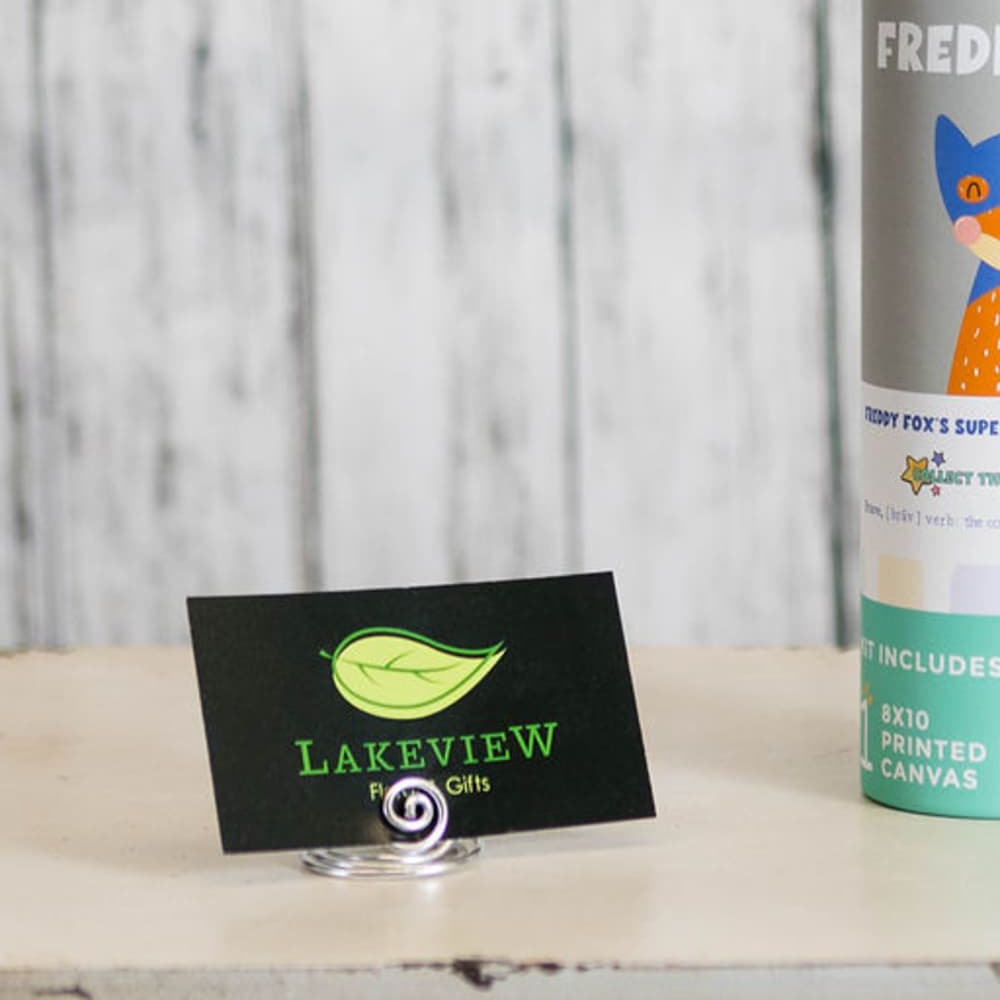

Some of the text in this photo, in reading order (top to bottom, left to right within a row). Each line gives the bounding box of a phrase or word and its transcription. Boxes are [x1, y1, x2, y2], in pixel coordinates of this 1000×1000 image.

[903, 414, 949, 434] FOX'S
[881, 704, 929, 731] 8X10
[294, 722, 558, 776] LAKEVIEW
[881, 732, 987, 763] PRINTED
[445, 774, 491, 796] Gifts
[881, 759, 979, 790] CANVAS
